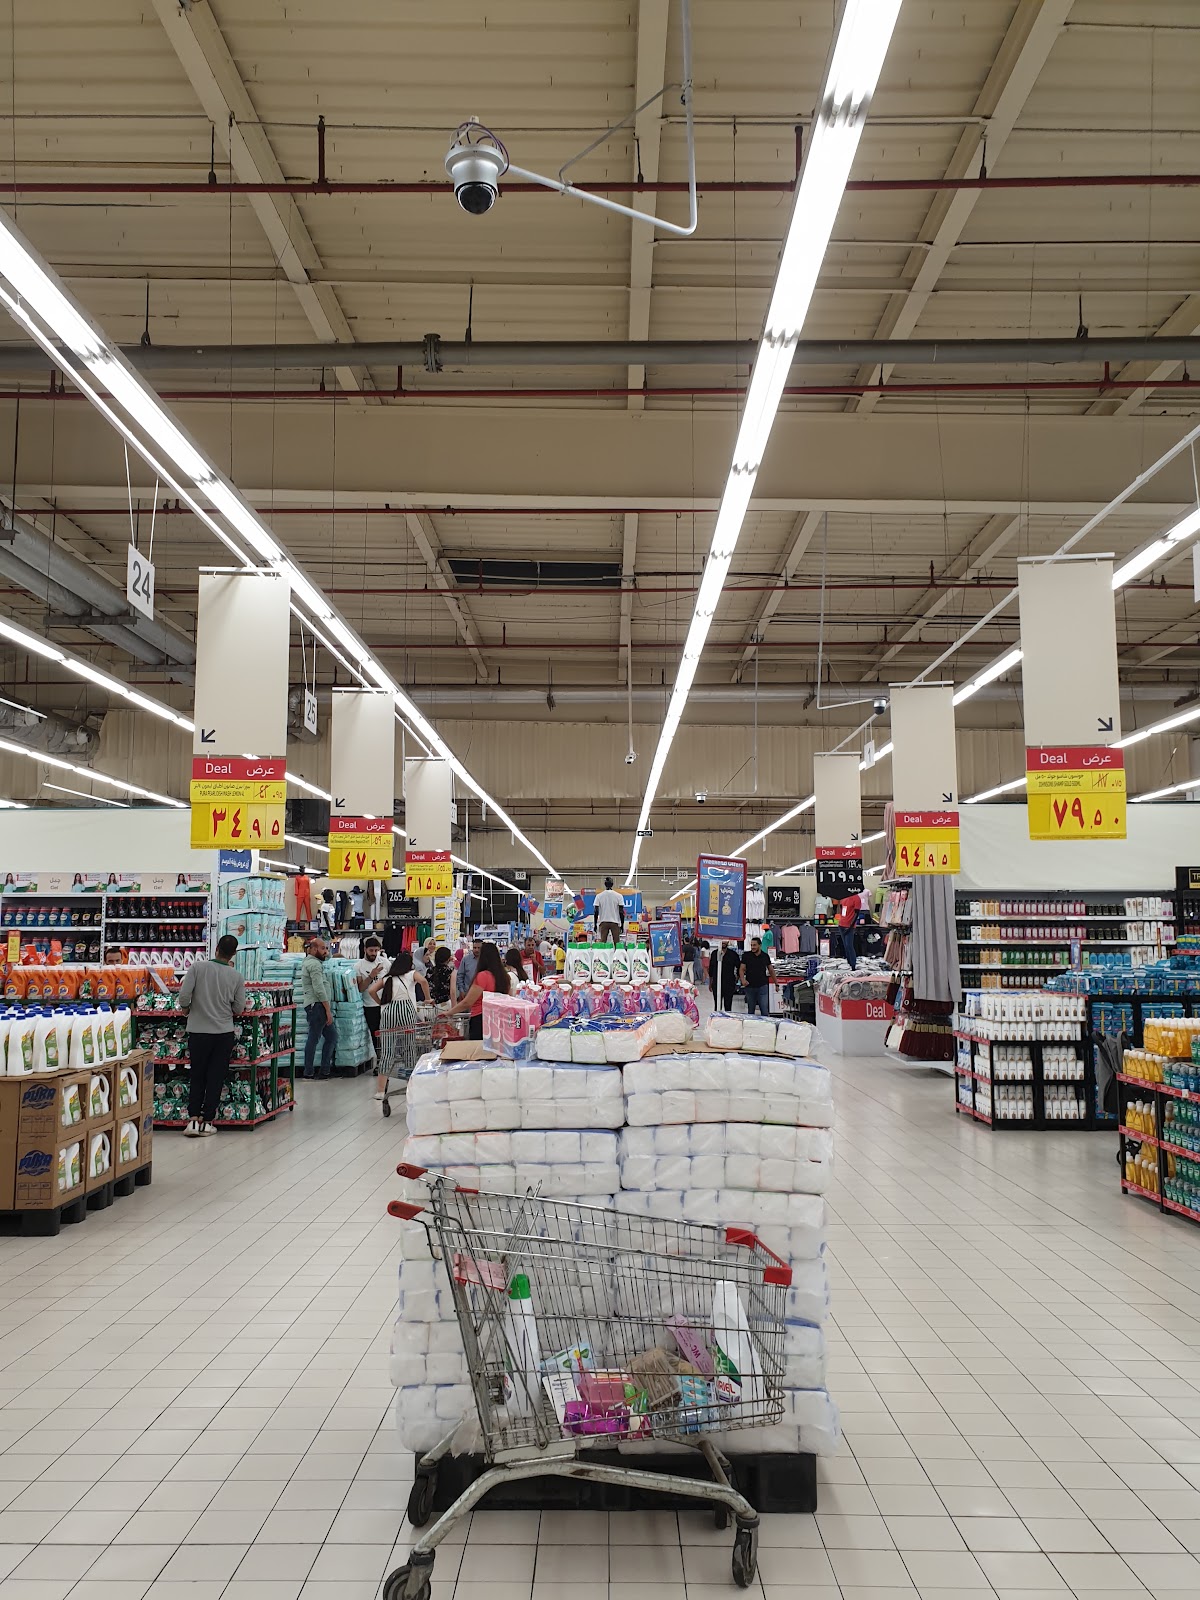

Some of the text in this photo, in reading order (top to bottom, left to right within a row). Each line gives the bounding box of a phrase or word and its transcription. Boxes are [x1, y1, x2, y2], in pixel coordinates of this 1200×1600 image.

[132, 560, 151, 604] 24
[307, 699, 316, 725] 25
[1040, 753, 1068, 764] Deal
[1082, 753, 1112, 765] عرض
[205, 763, 232, 774] Deal
[246, 765, 275, 777] عرض
[904, 815, 922, 823] Deal
[932, 816, 952, 825] عرض
[338, 821, 357, 829] Deal
[366, 823, 386, 831] عرض
[389, 891, 403, 902] 265
[866, 1002, 887, 1018] Deal
[22, 1088, 57, 1104] PURA
[18, 1154, 53, 1168] PURA
